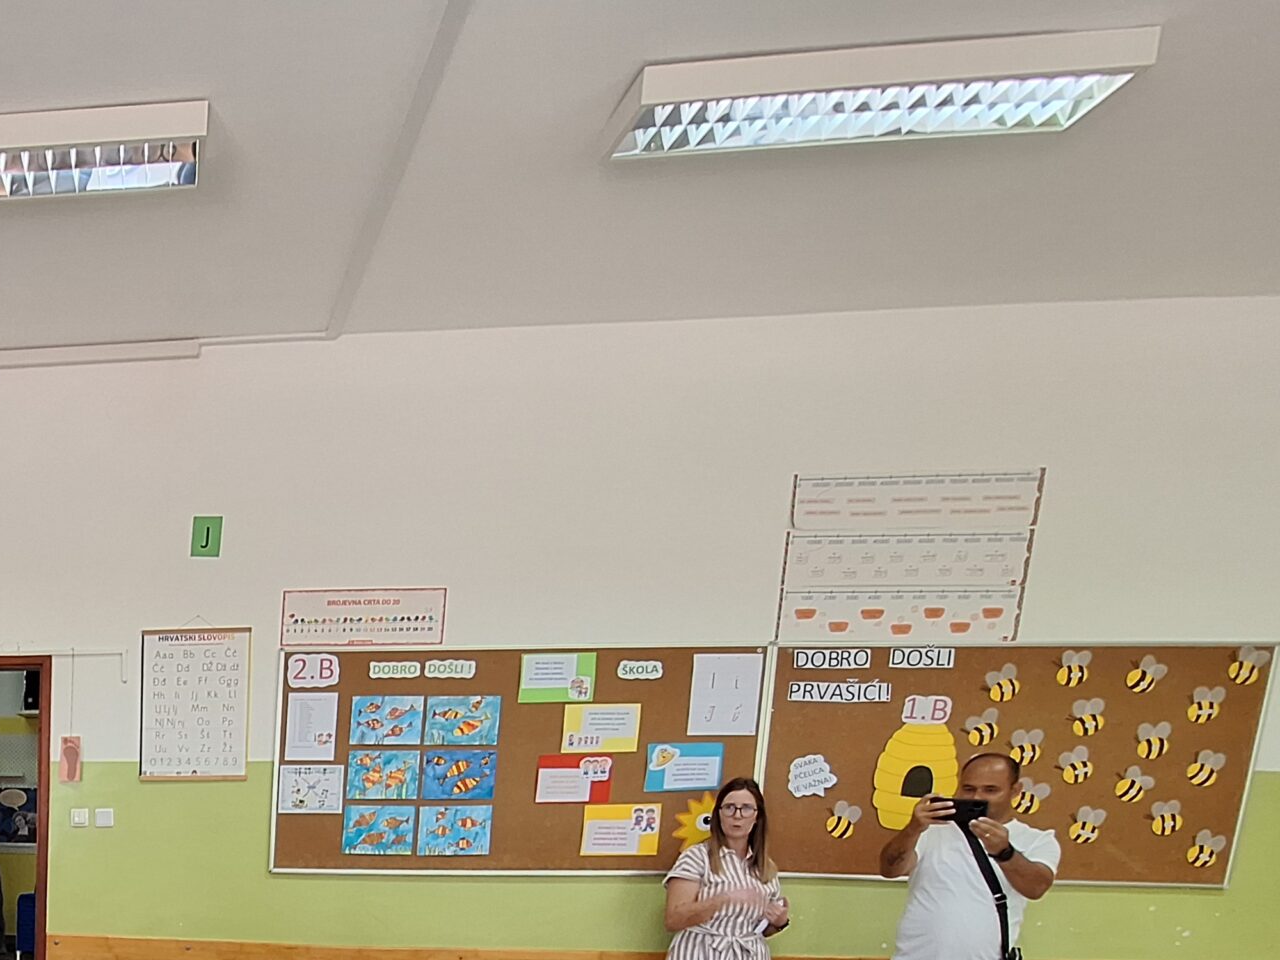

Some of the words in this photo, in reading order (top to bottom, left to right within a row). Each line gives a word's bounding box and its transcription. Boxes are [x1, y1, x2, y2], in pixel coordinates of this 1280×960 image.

[200, 526, 210, 549] J
[158, 634, 196, 642] HRVATSKI
[198, 633, 235, 641] SLOVOPIS
[795, 649, 869, 668] DOBRO
[891, 645, 952, 667] DOŠLI
[293, 658, 334, 680] 2.B
[372, 664, 418, 675] DOBRO
[622, 663, 659, 676] ŠKOLA
[789, 679, 891, 701] PRVAŠIĆI!
[904, 697, 948, 721] 1.B
[794, 758, 818, 770] SVAKA
[794, 767, 825, 780] PČELICA
